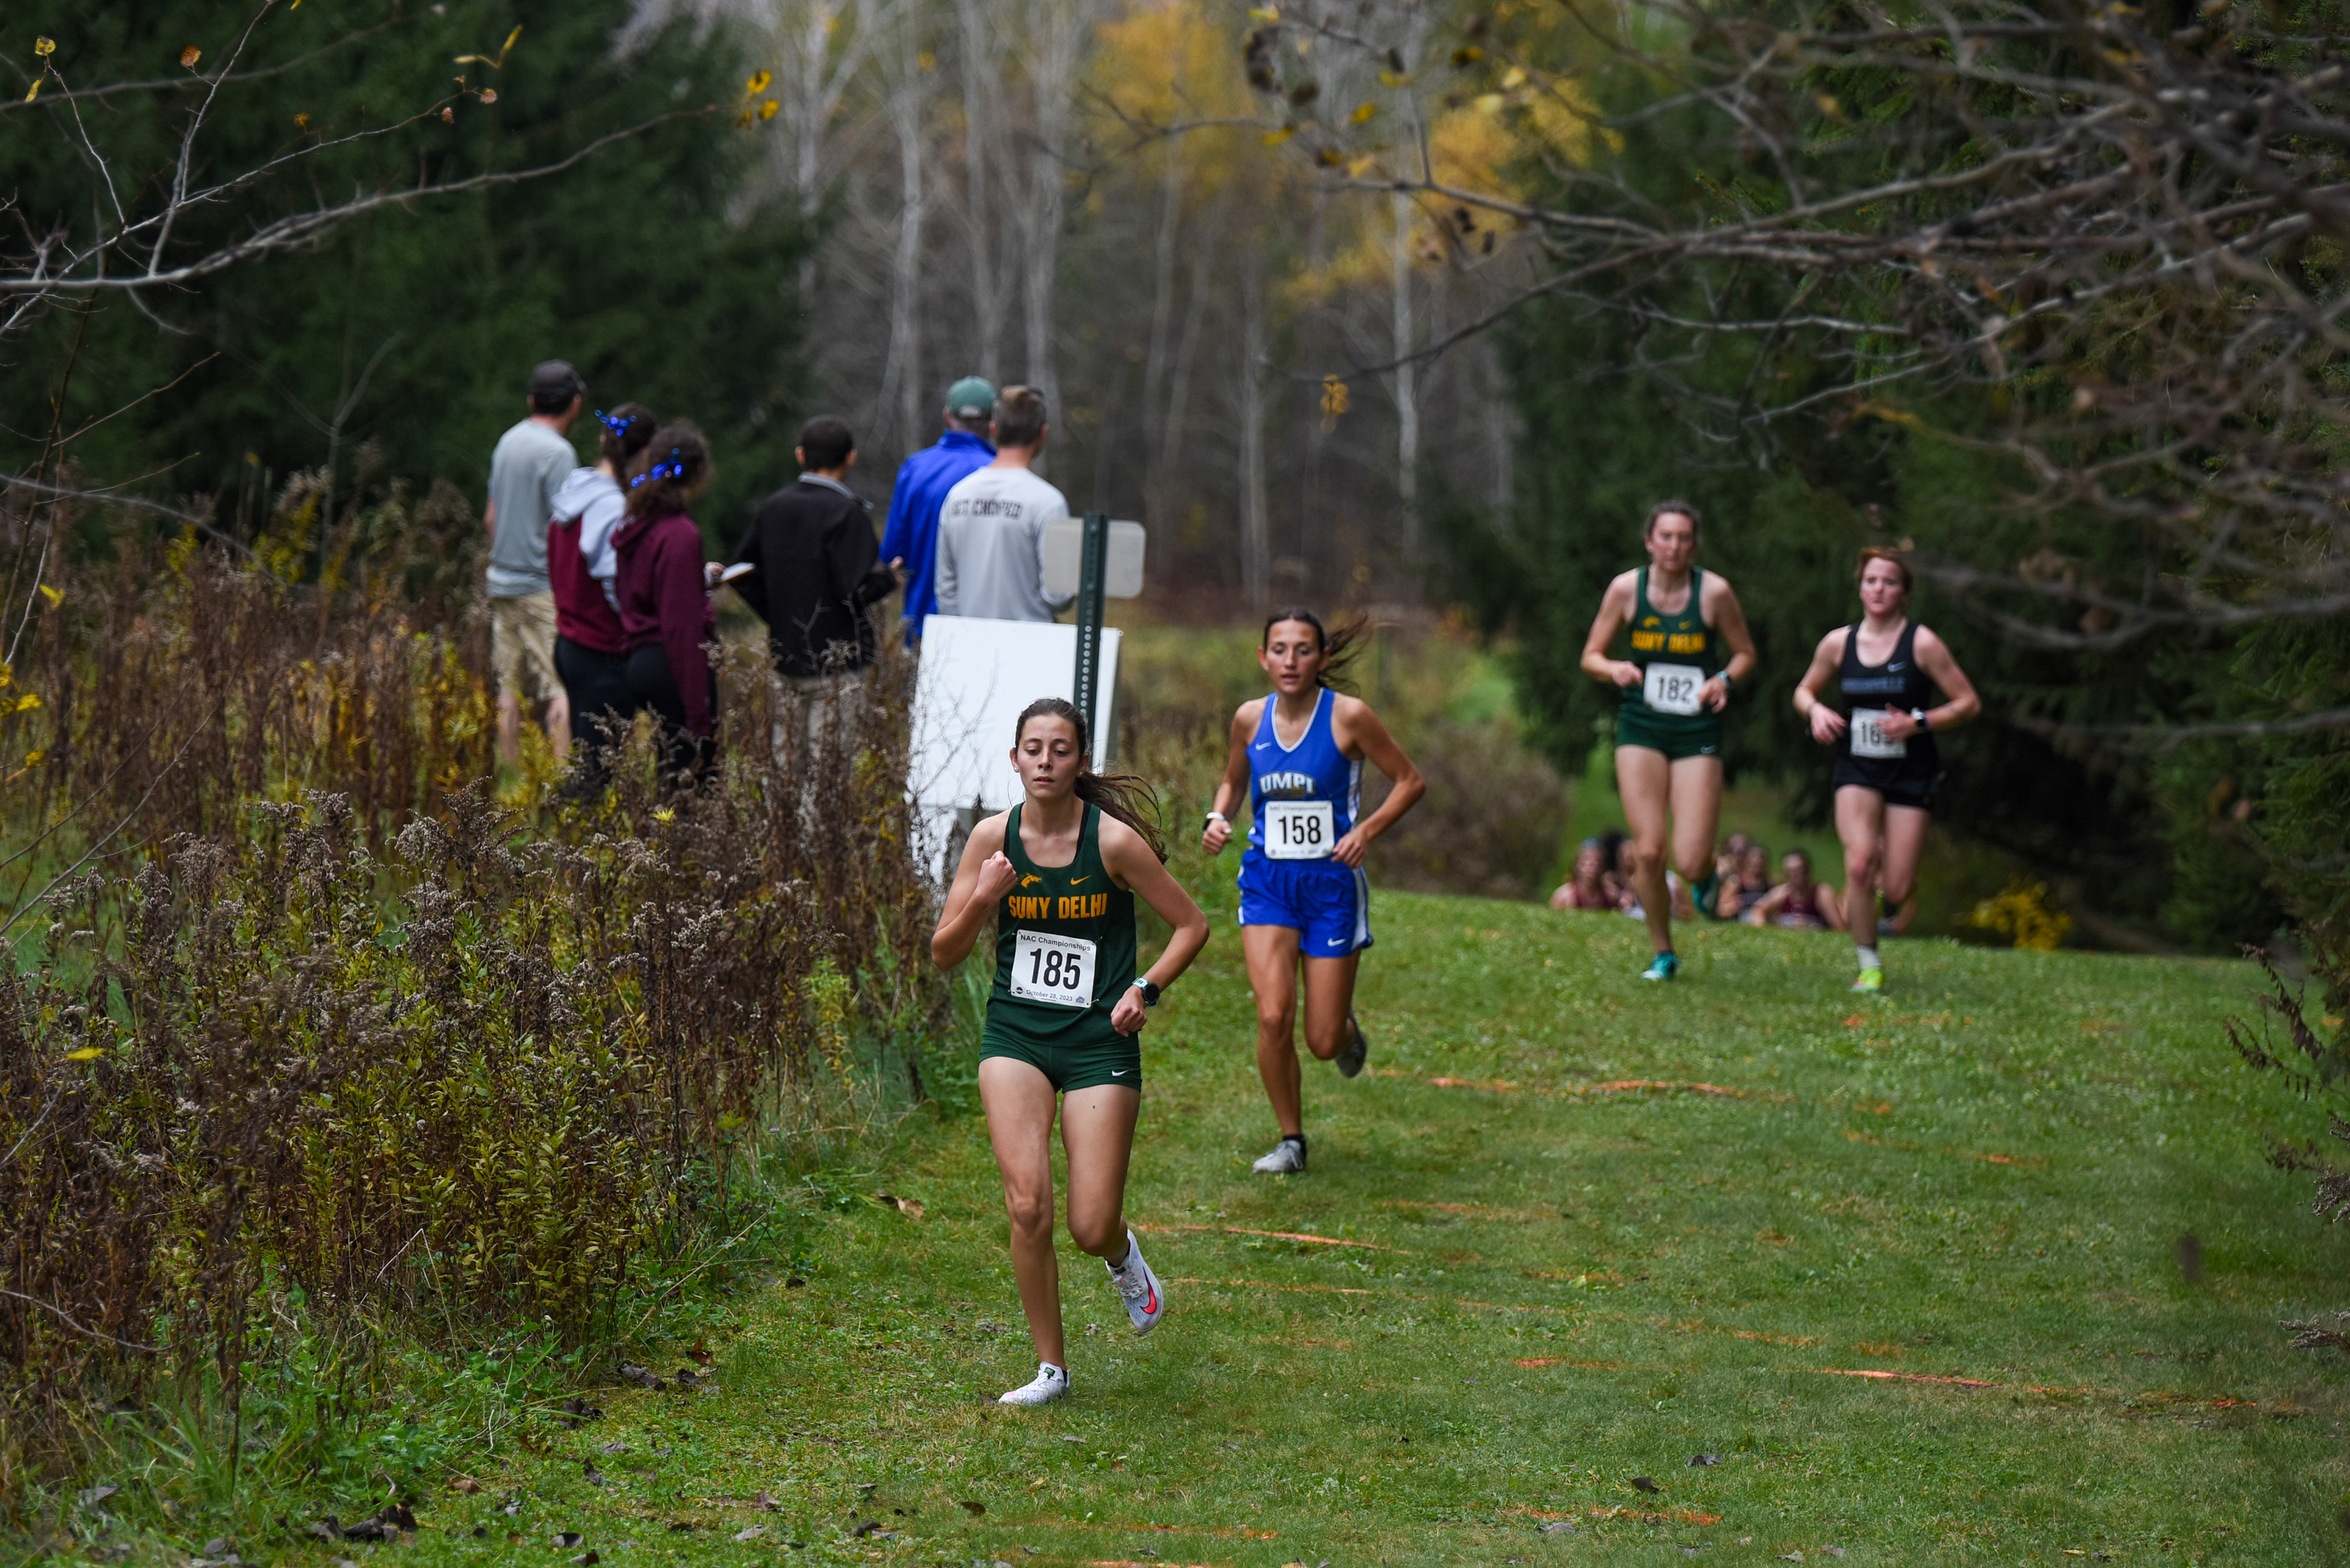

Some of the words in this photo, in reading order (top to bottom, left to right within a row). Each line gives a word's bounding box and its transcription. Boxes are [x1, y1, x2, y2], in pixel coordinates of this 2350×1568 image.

[1631, 630, 1666, 652] SUNY
[1656, 675, 1694, 703] 182
[1259, 771, 1314, 794] UMPI
[1278, 815, 1322, 845] 158
[1008, 895, 1051, 919] SUNY
[1058, 892, 1108, 919] DELHI
[1020, 933, 1037, 943] NAC
[1038, 936, 1091, 952] Championships
[1029, 947, 1081, 990] 185
[1026, 989, 1048, 998] October
[1059, 994, 1073, 1002] 2023
